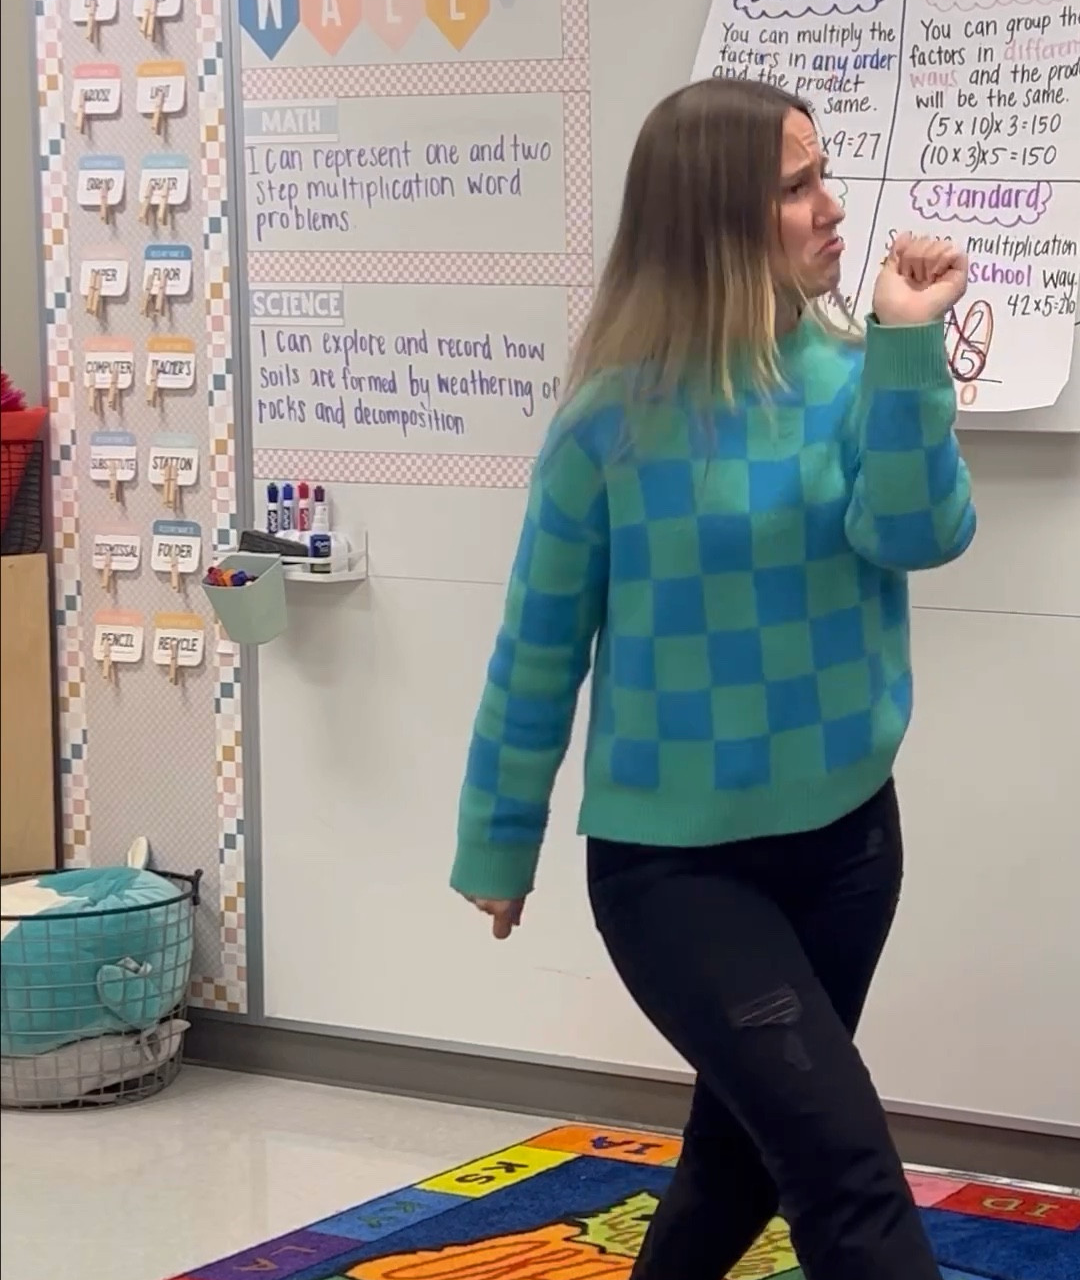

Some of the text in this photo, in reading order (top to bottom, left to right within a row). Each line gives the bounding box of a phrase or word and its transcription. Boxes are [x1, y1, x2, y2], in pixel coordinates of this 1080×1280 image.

[722, 22, 896, 52] You can multiply the
[921, 19, 951, 42] You
[964, 19, 997, 38] can
[1006, 15, 1051, 45] group
[719, 44, 897, 77] factors in any order
[909, 45, 966, 68] factors
[977, 44, 995, 63] in
[758, 68, 789, 89] the
[796, 74, 866, 96] product
[910, 69, 958, 88] ways
[969, 63, 1001, 86] and
[1010, 63, 1042, 84] the
[916, 90, 944, 109] will
[958, 89, 978, 108] be
[987, 88, 1018, 107] the
[261, 109, 321, 133] MATH
[247, 133, 552, 177] I can represent one and two
[256, 168, 522, 208] step multiplication word
[966, 234, 1078, 262] multiplication
[253, 292, 341, 316] SCIENCE
[260, 328, 545, 366] I can explore and record how
[260, 364, 561, 418] soils are formed by weathering of
[258, 395, 465, 438] rocks and decomposition
[152, 456, 193, 471] STATION
[100, 633, 135, 648] PENCIL
[592, 1135, 665, 1156] IA
[454, 1160, 530, 1187] KS
[980, 1195, 1061, 1218] ID
[232, 1245, 318, 1274] LA
